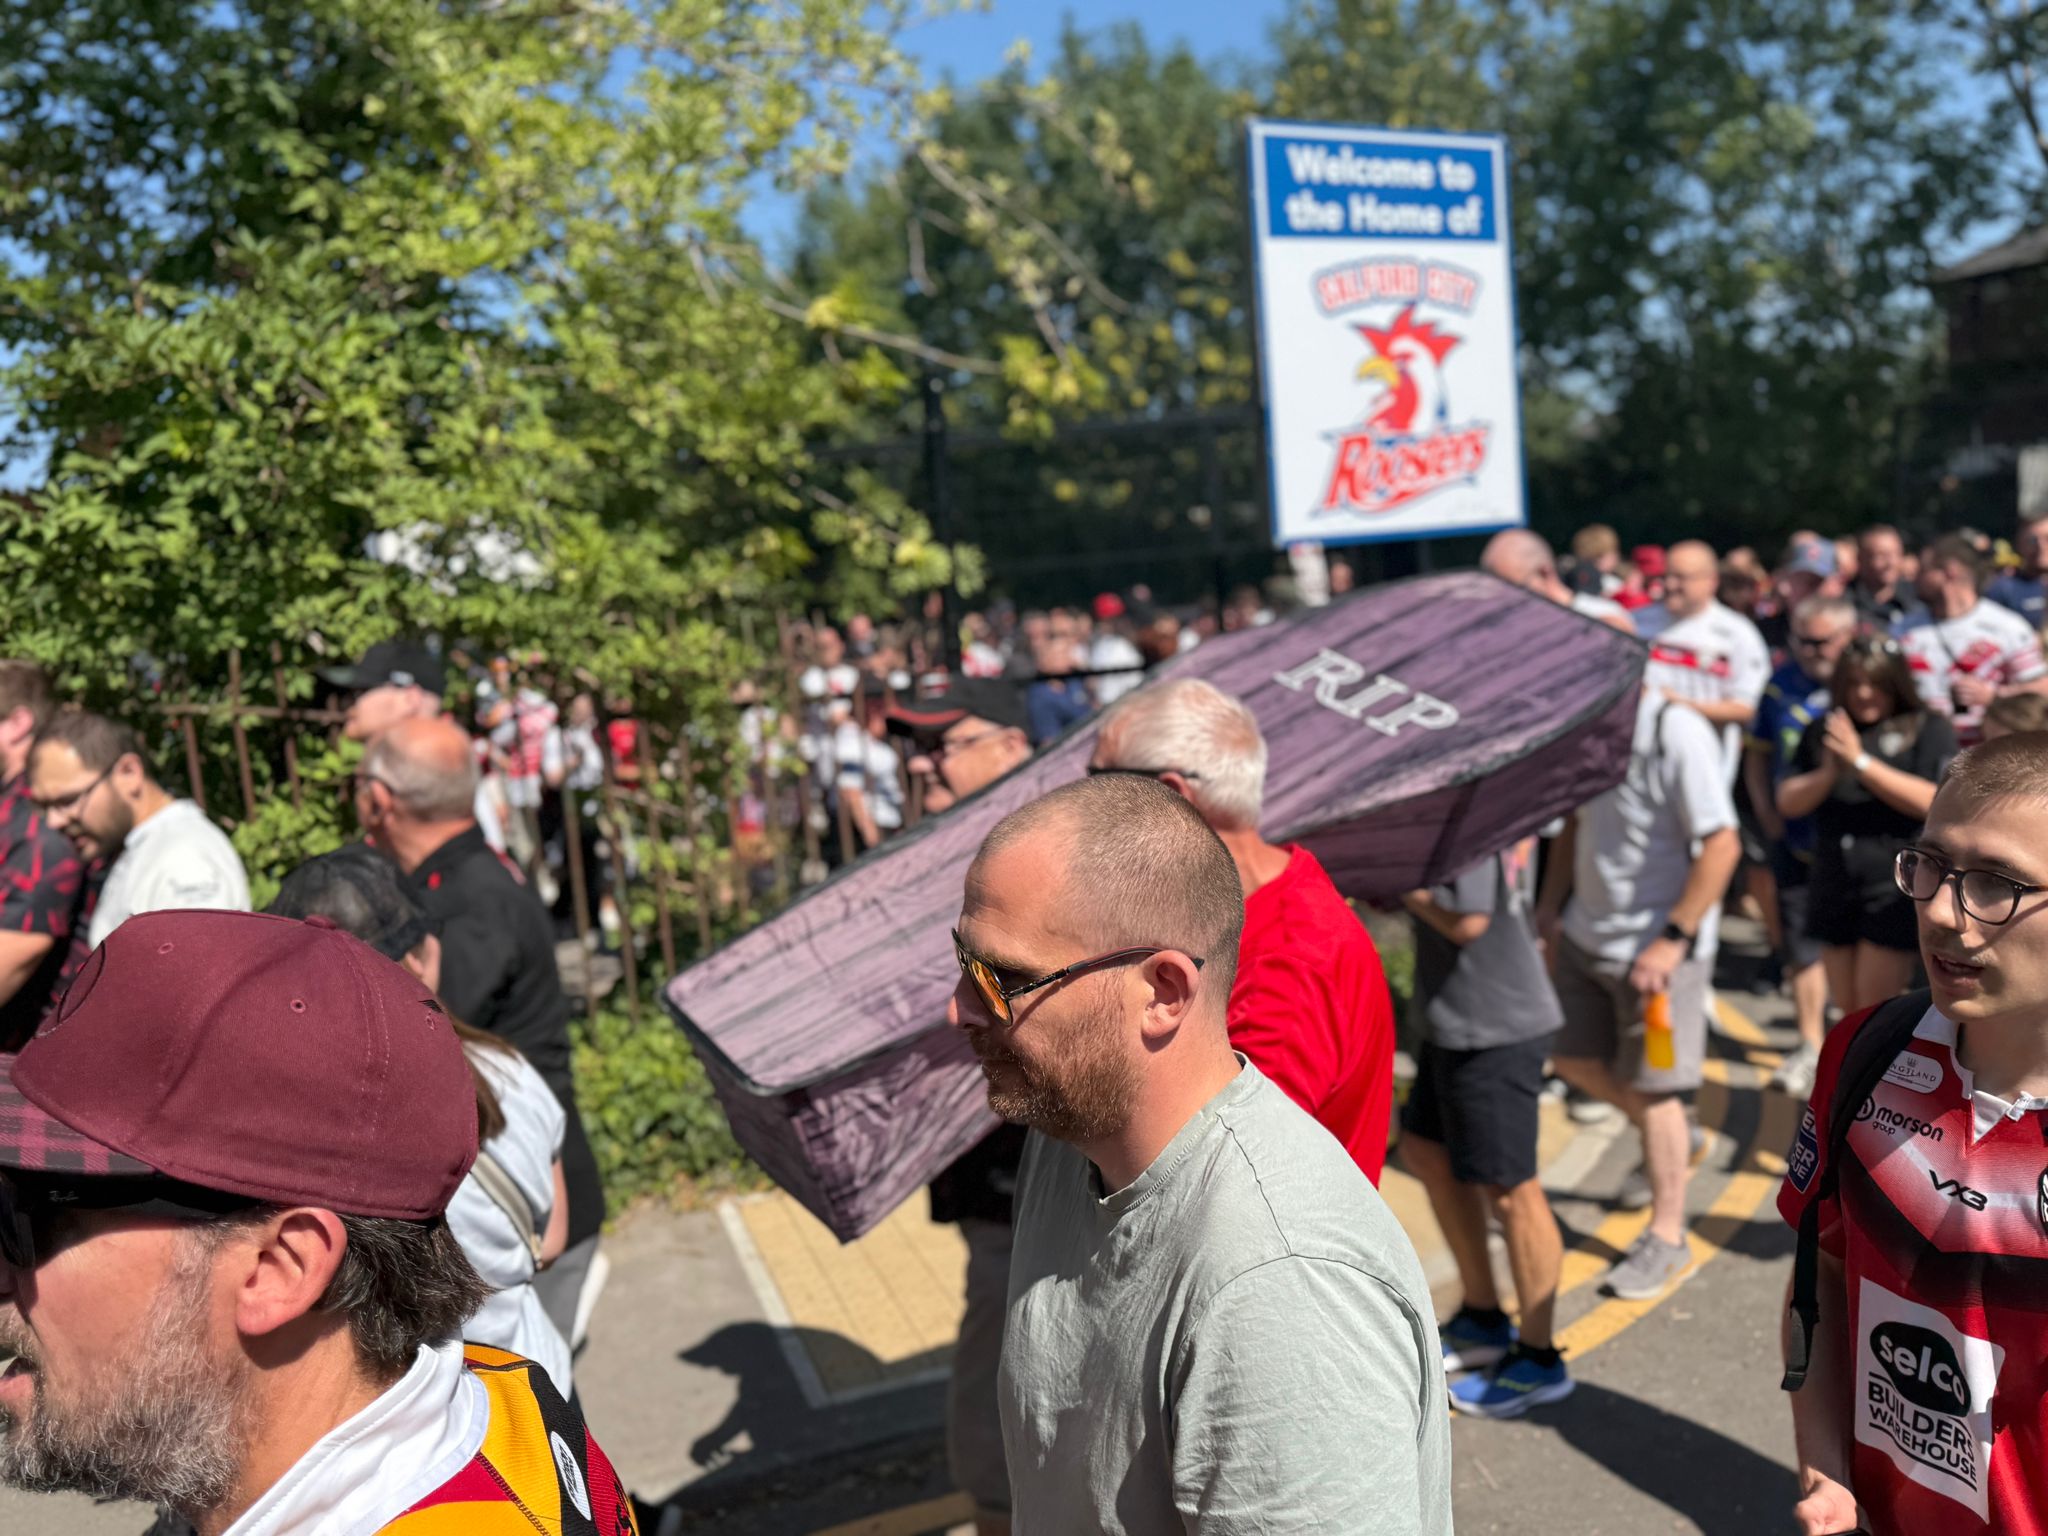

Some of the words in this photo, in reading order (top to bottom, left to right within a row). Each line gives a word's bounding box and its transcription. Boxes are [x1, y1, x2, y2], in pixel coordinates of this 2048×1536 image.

[1286, 143, 1435, 190] Welcome
[1439, 156, 1476, 191] to
[1286, 191, 1344, 232] the
[1348, 194, 1443, 234] Home
[1446, 197, 1483, 235] of
[1273, 647, 1460, 736] RIP
[1889, 1063, 1937, 1082] NGSLAND
[1872, 1120, 1897, 1136] group
[1876, 1107, 1944, 1142] morson
[1929, 1169, 1988, 1211] VX3
[1879, 1335, 1965, 1405] selco
[1868, 1404, 1976, 1482] WAREHOUSE
[1869, 1382, 1975, 1462] BUILDERS
